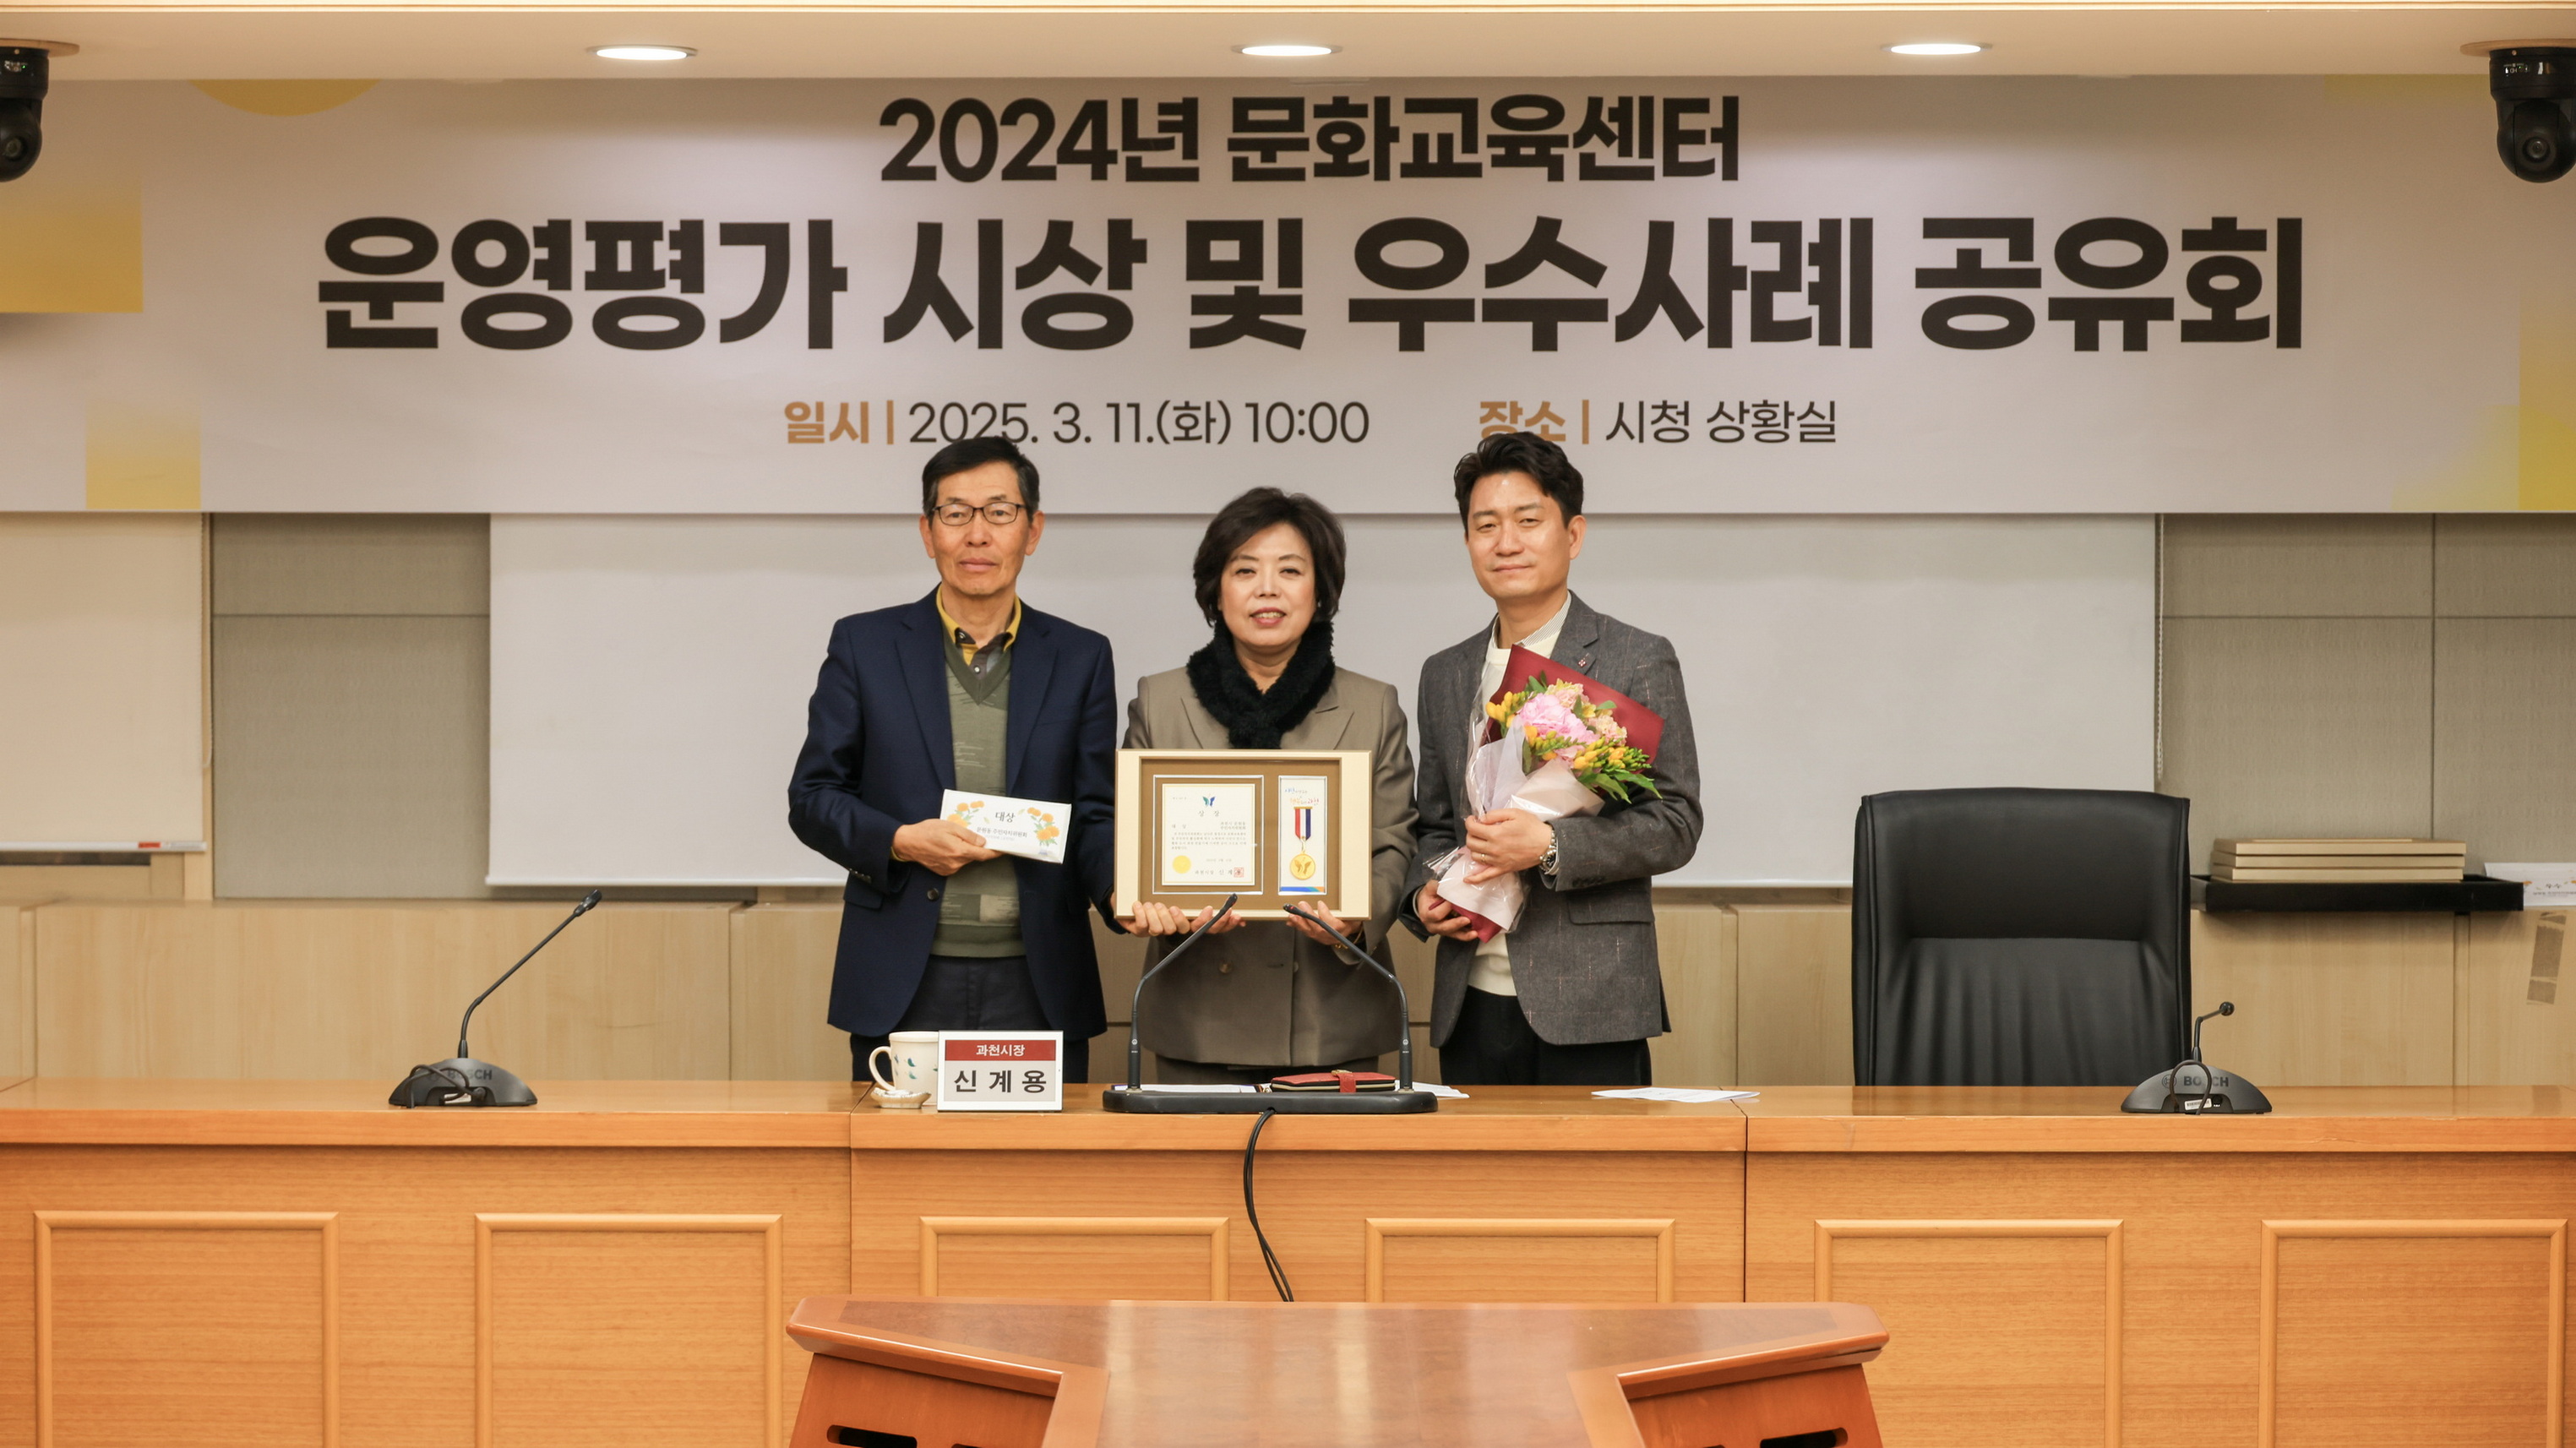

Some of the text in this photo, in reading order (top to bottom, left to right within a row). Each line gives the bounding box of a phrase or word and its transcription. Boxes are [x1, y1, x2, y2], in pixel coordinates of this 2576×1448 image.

[880, 94, 1740, 183] 2024년 문화교육센터
[318, 215, 2303, 352] 운영평가 시상 및 우수사례 공유회
[784, 400, 1370, 444] 일시 2025. 3. 11.(화) 10:00
[1479, 400, 1836, 444] 장소 시청 상황실
[995, 811, 1016, 823] 대상
[976, 1044, 1026, 1057] 과천시장
[447, 1069, 493, 1081] BSCH
[2183, 1075, 2229, 1087] BOCH
